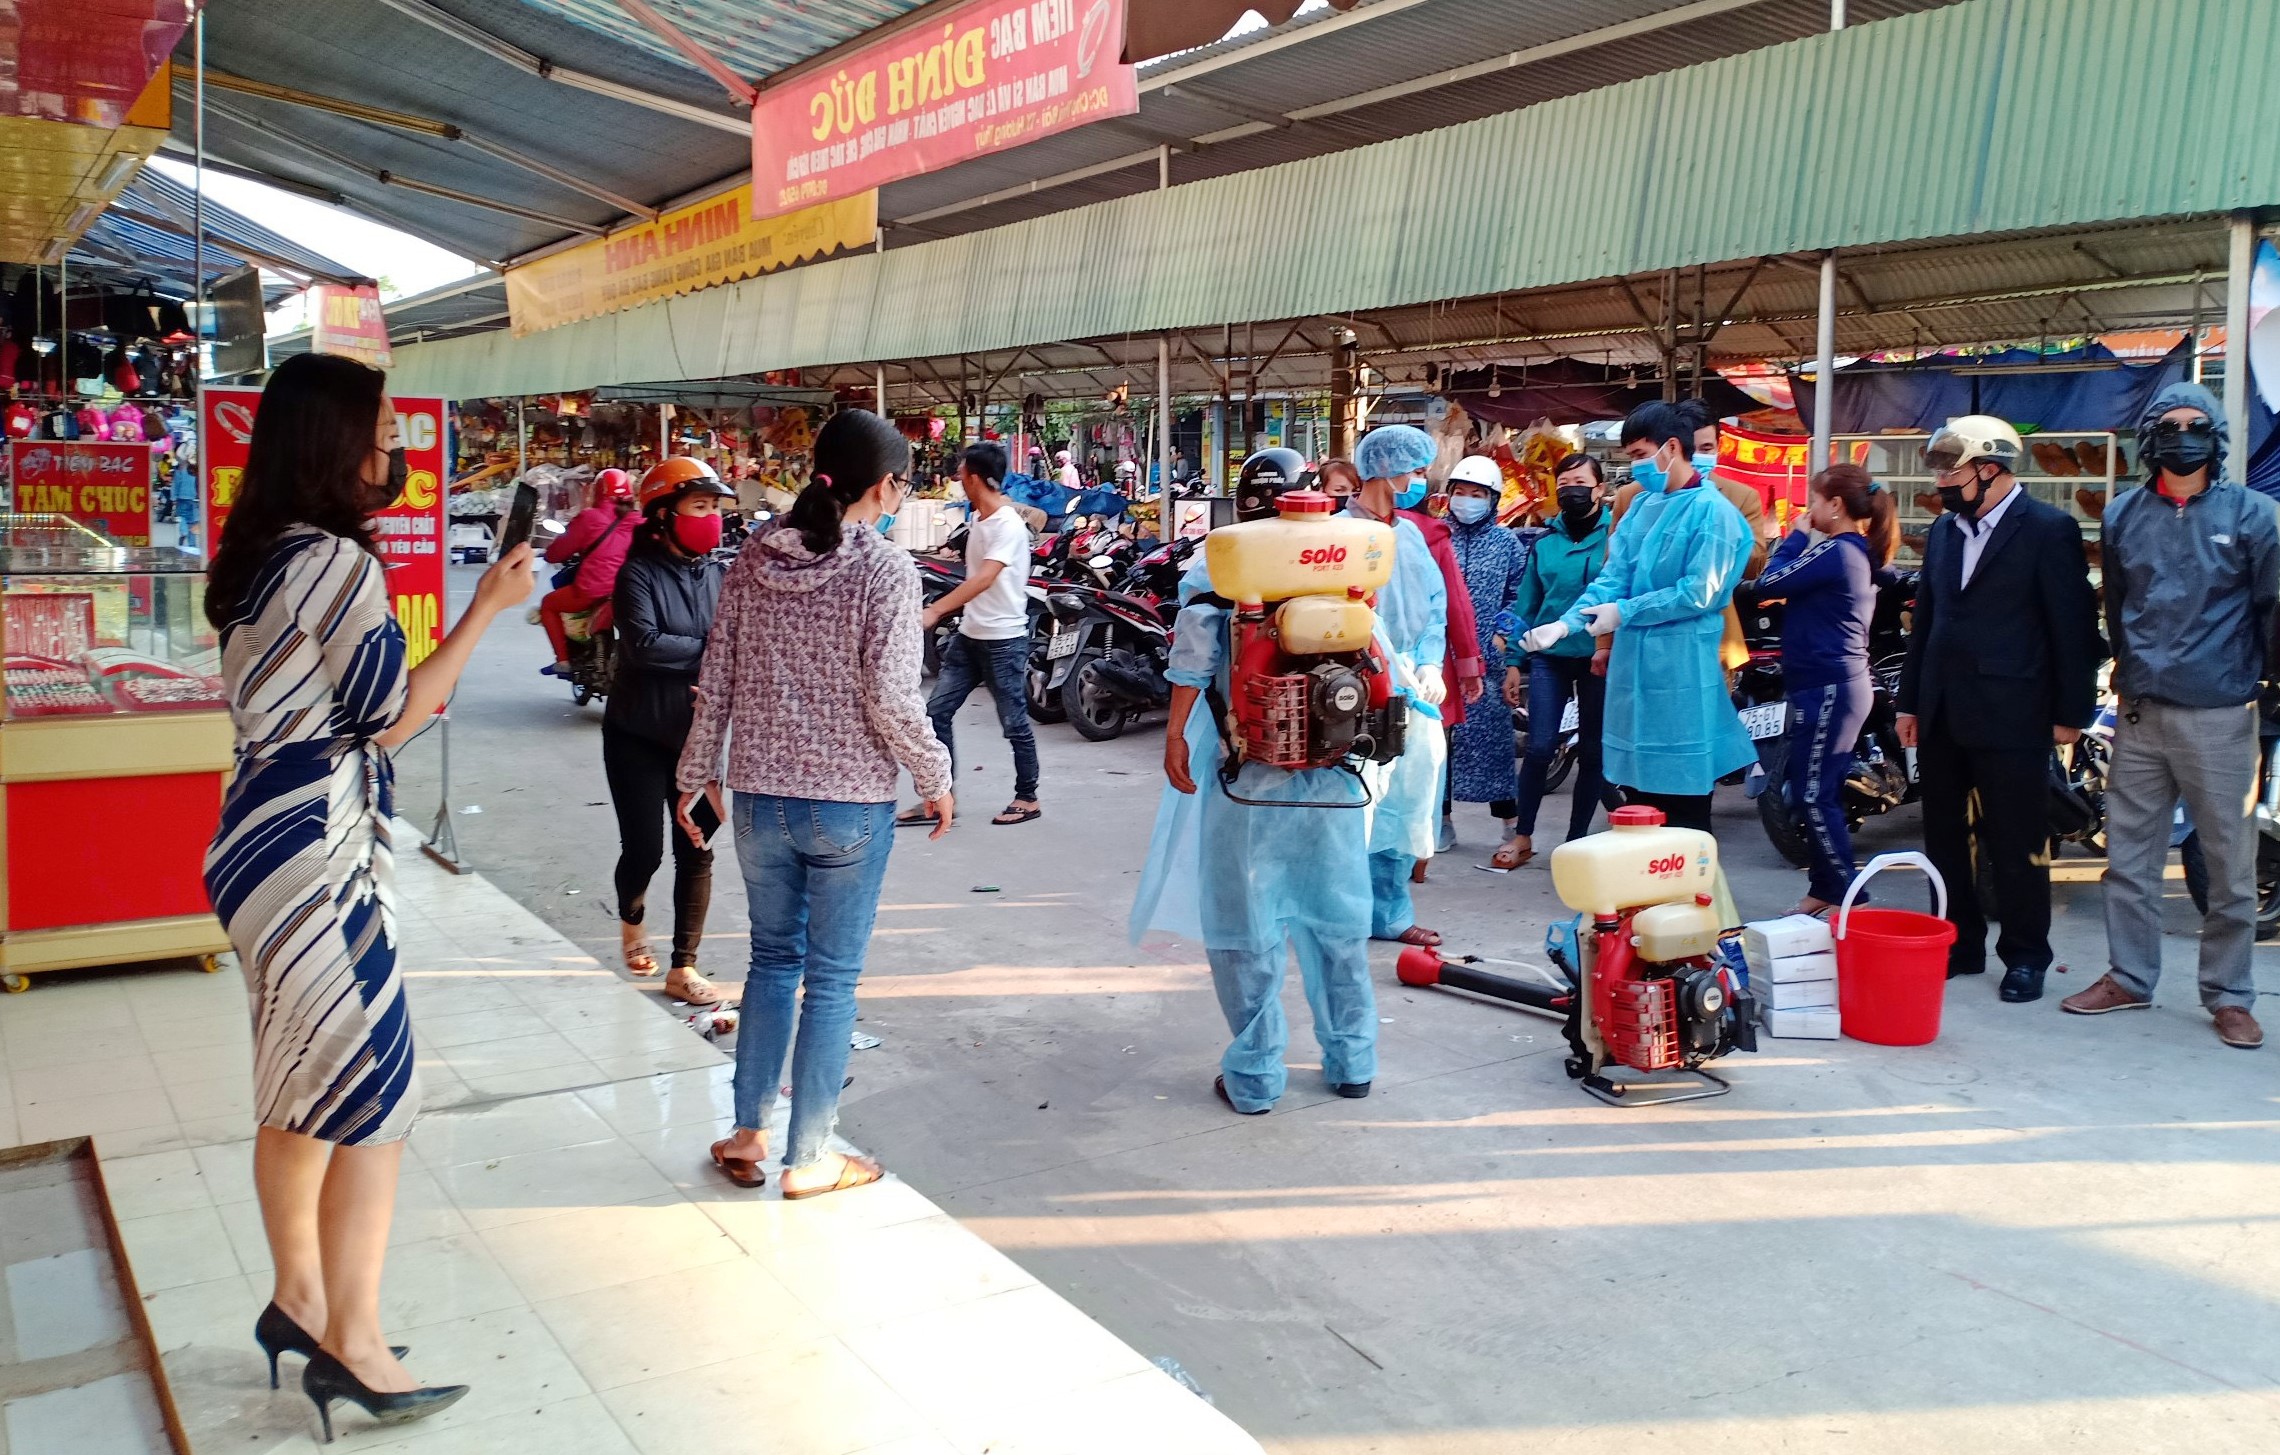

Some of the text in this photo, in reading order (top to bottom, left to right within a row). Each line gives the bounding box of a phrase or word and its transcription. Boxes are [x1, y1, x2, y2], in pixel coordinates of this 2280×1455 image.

[18, 479, 146, 513] TÂM CHÚC
[412, 511, 436, 535] CHẤT
[391, 540, 411, 554] YÊU
[412, 537, 436, 554] CẦU
[1299, 544, 1347, 565] solo
[1648, 853, 1684, 874] solo
